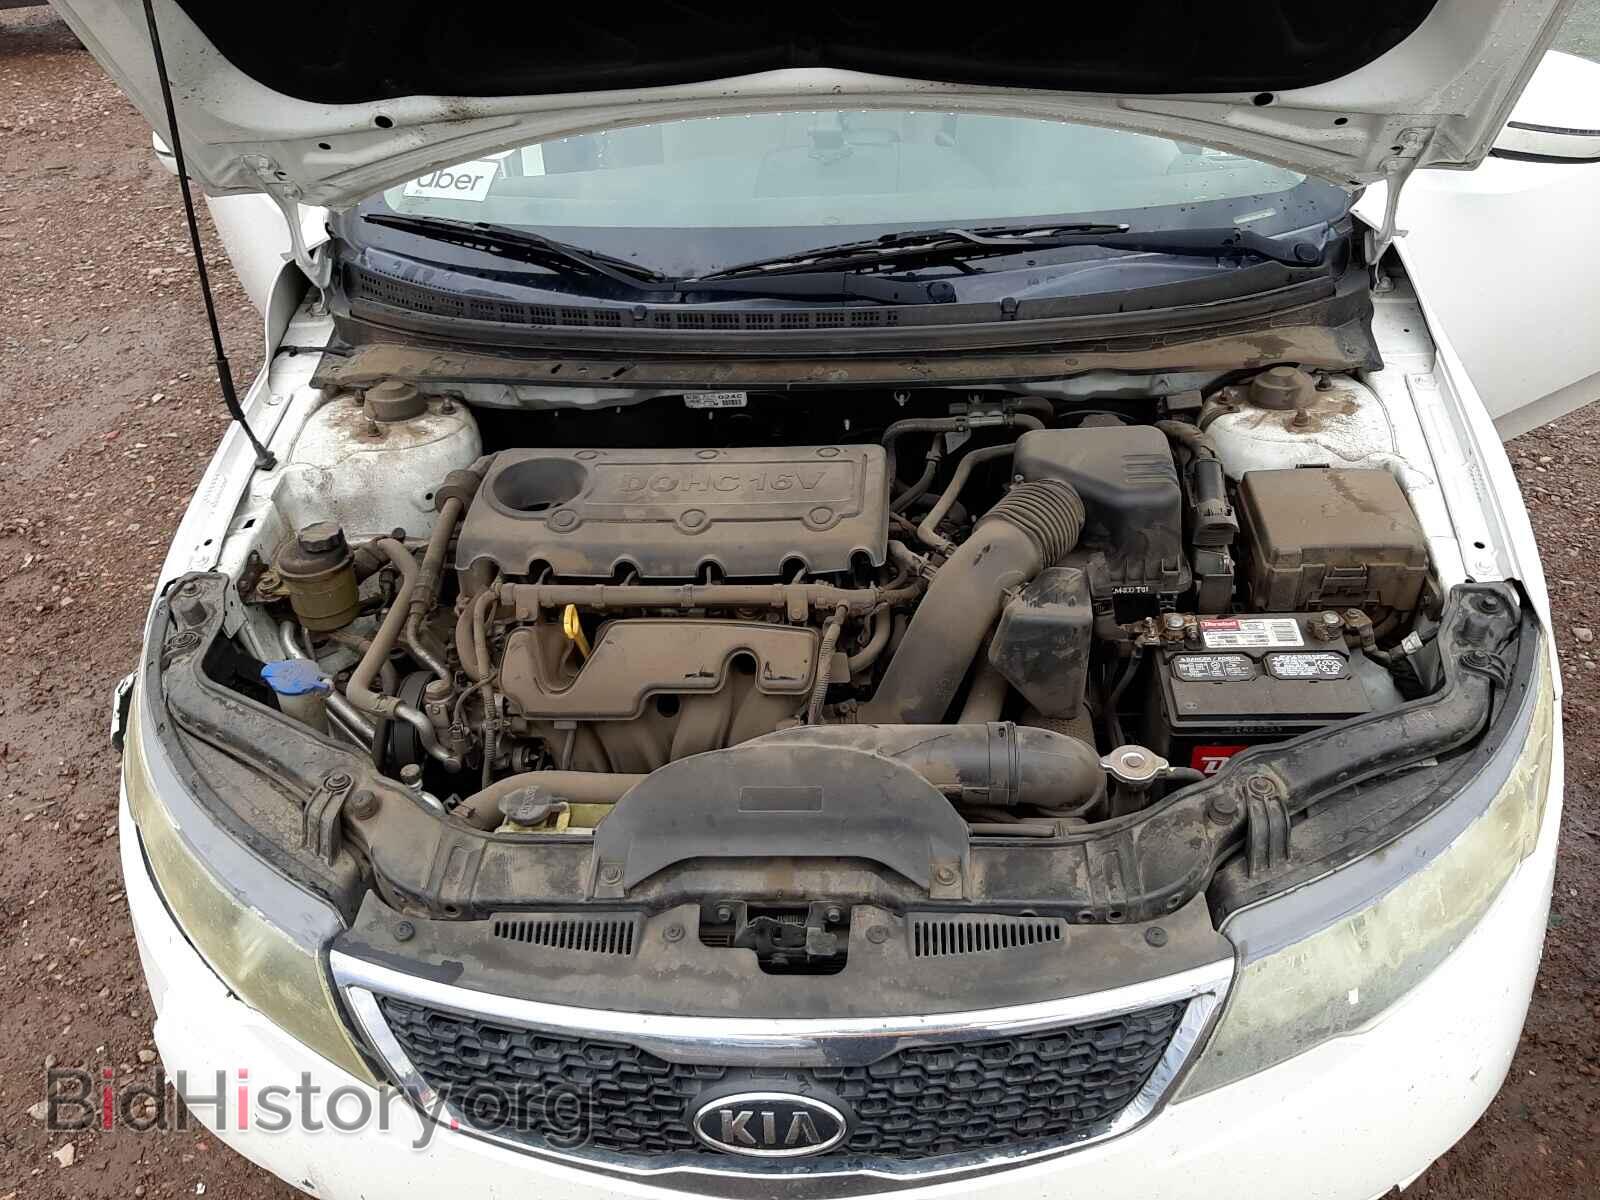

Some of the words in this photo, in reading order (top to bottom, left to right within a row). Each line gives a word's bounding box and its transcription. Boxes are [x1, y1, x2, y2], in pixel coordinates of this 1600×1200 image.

[621, 471, 741, 492] DOHC
[748, 470, 827, 491] 16V
[719, 1109, 821, 1145] KIA
